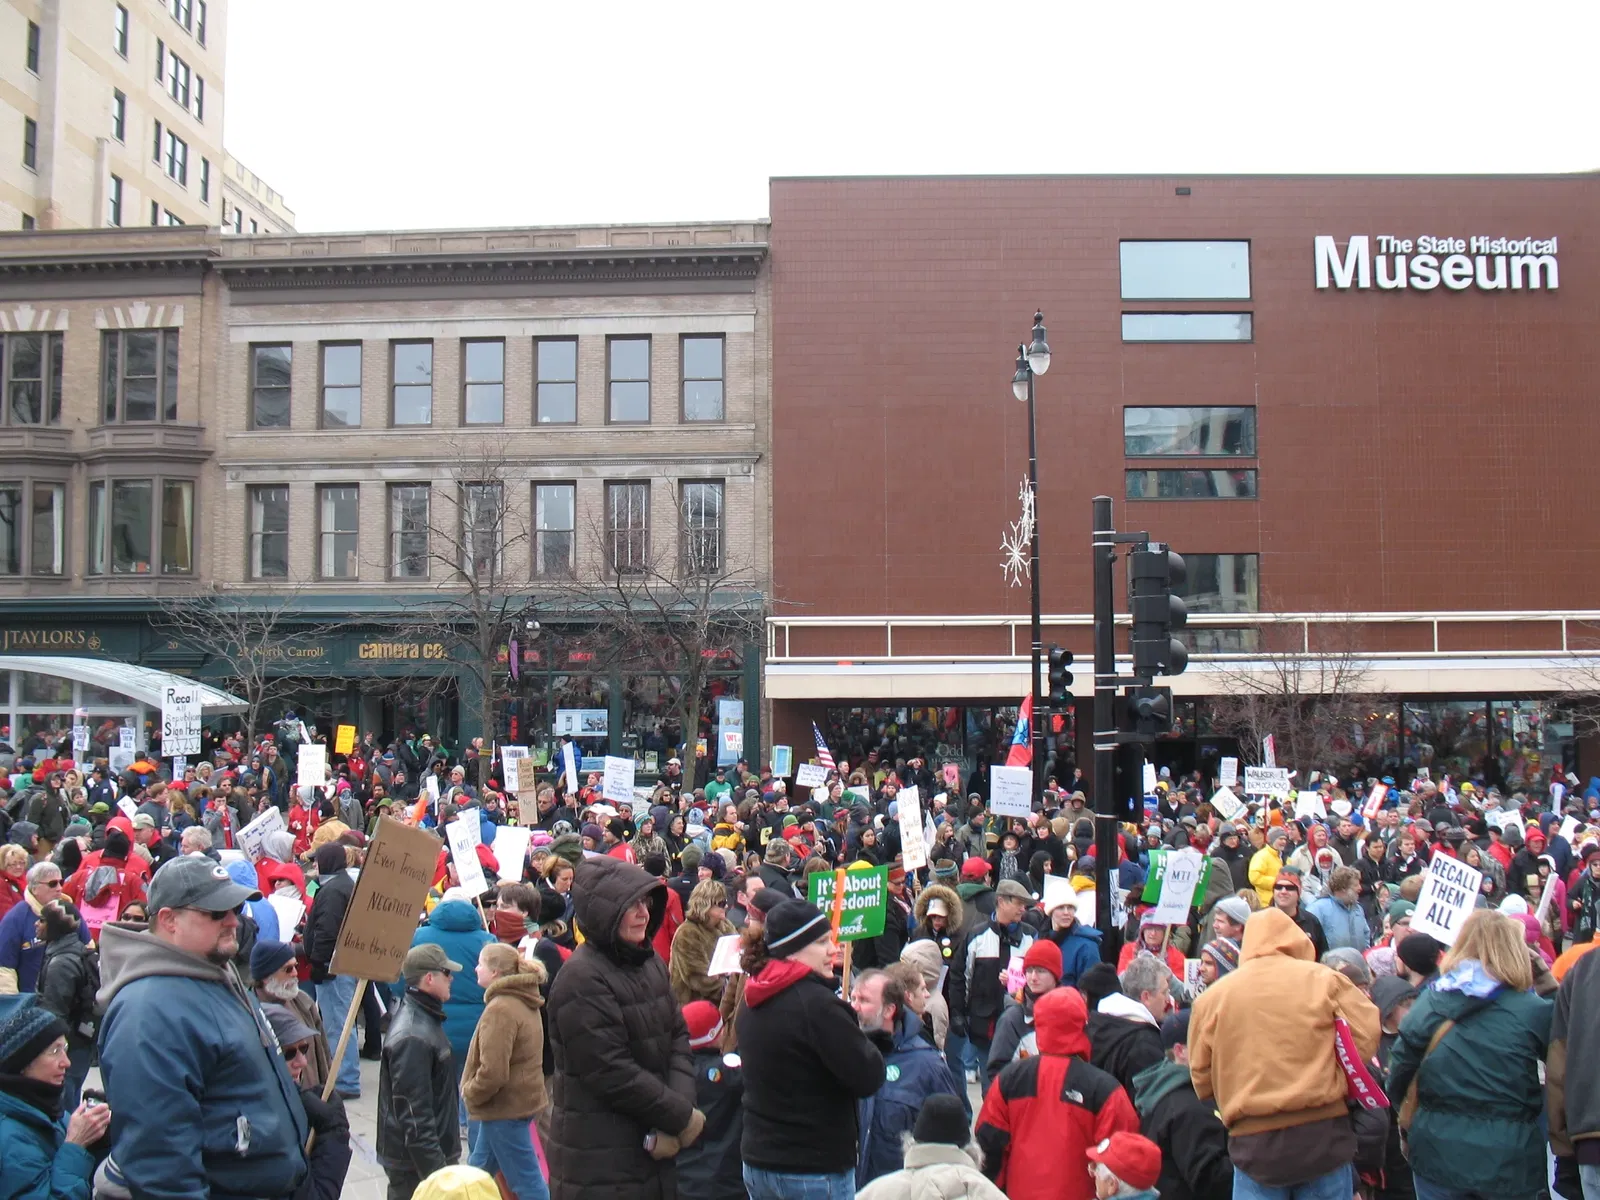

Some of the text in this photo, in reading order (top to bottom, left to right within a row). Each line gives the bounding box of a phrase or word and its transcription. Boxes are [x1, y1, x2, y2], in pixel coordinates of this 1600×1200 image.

[1376, 235, 1558, 255] The State Historical
[1314, 235, 1559, 290] Museum
[287, 646, 323, 657] Carroll
[359, 643, 419, 659] camera
[167, 688, 199, 704] Recall
[165, 722, 184, 738] Sign
[1246, 769, 1275, 779] WALKER
[457, 838, 471, 851] MTI
[374, 841, 396, 872] Even
[1171, 870, 1191, 881] MTI
[1432, 857, 1475, 892] RECALL
[817, 873, 881, 896] It's About
[1430, 878, 1466, 908] THEM
[367, 891, 413, 918] NEGOTIATE
[1425, 902, 1452, 930] ALL
[1353, 1077, 1369, 1093] IN
